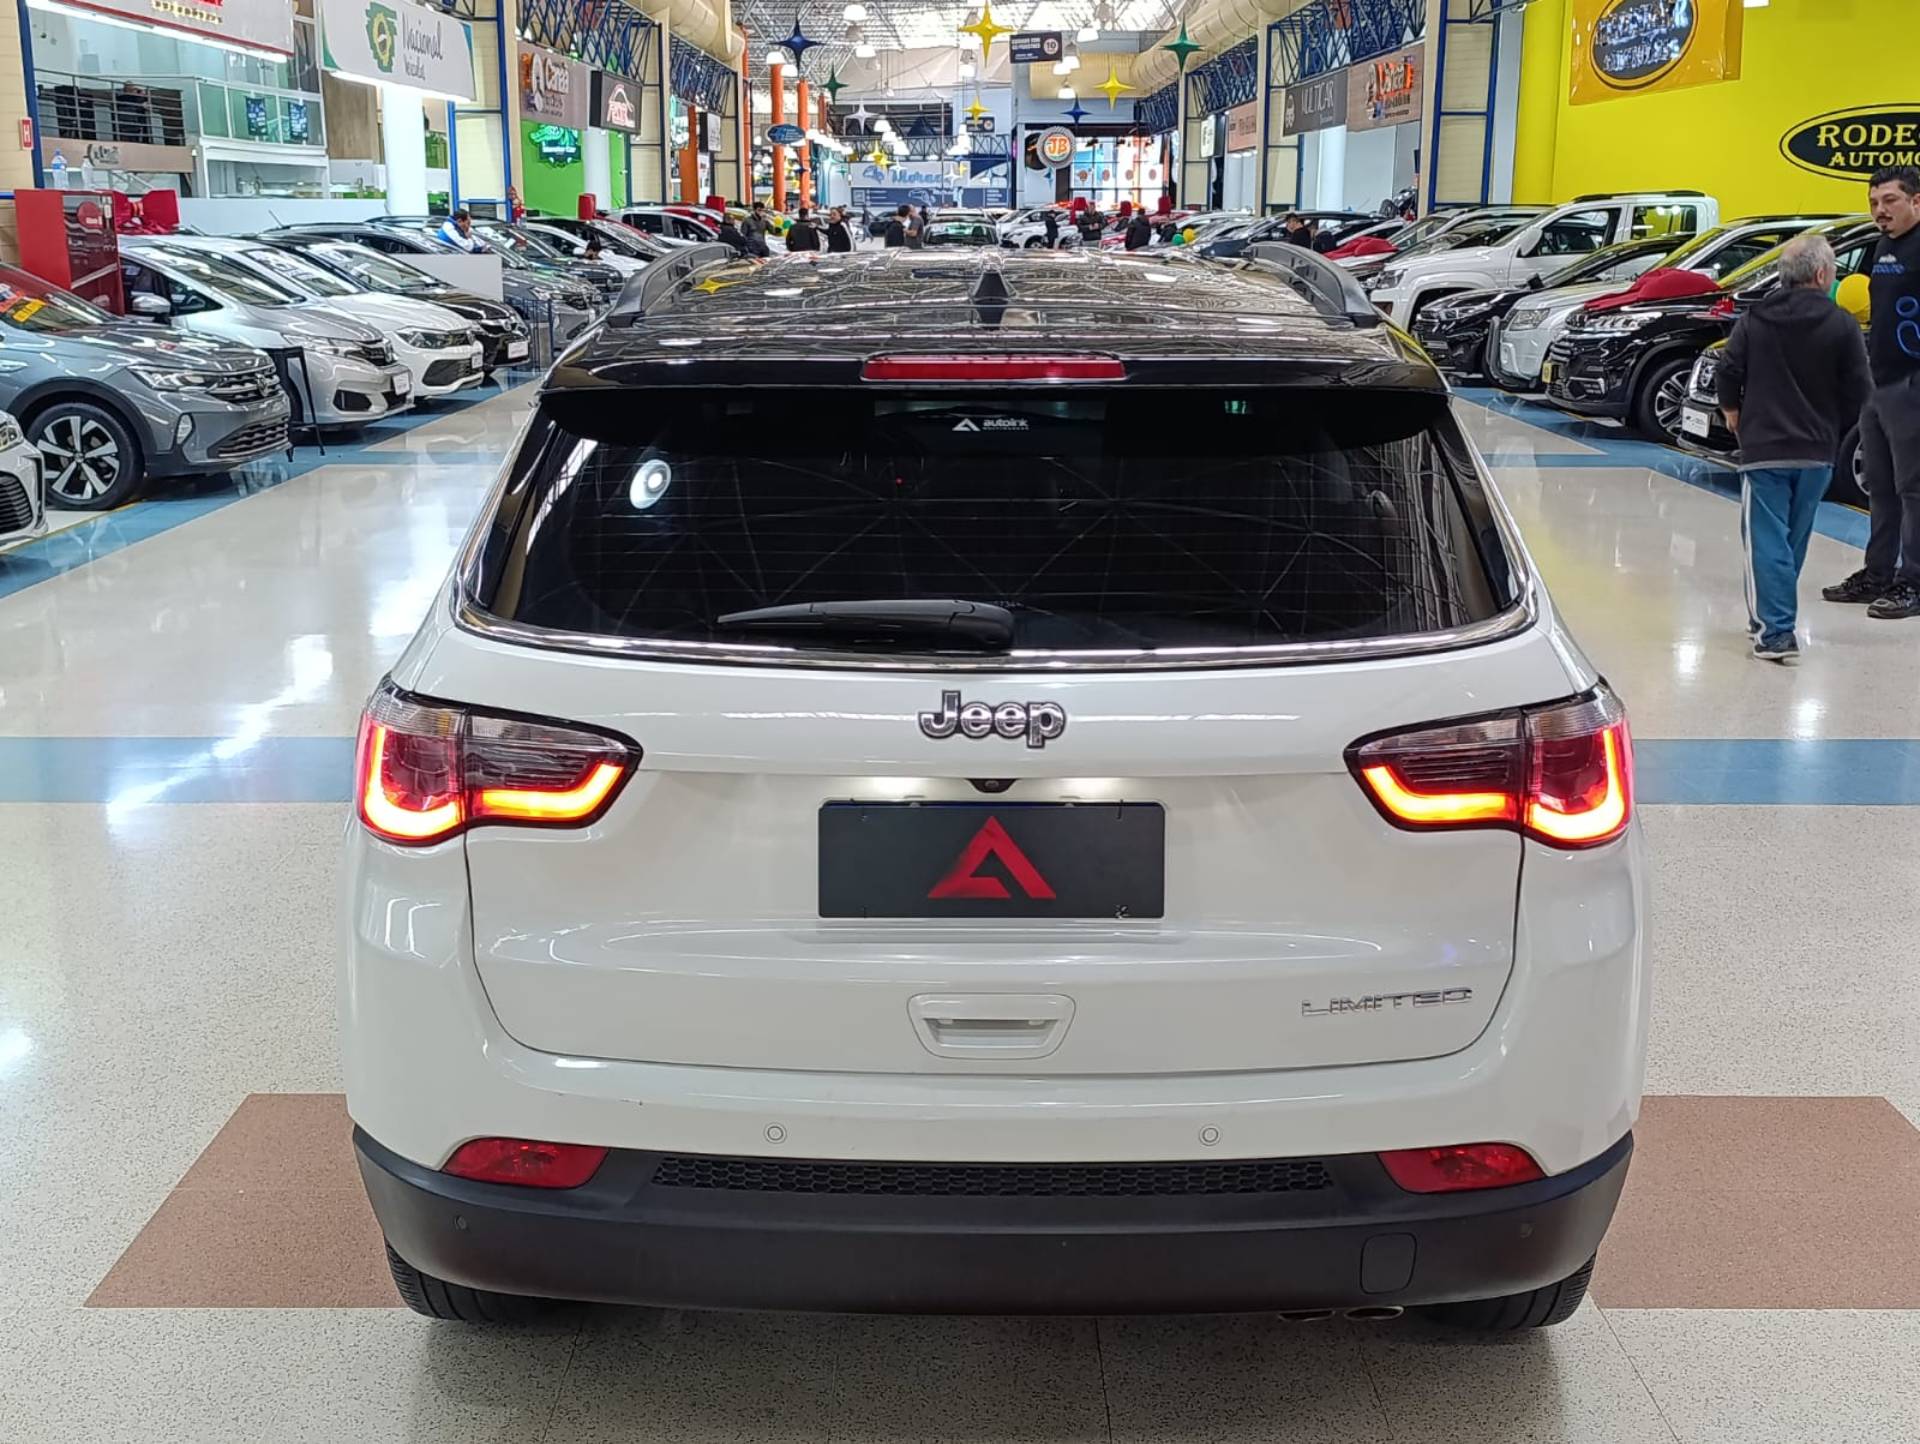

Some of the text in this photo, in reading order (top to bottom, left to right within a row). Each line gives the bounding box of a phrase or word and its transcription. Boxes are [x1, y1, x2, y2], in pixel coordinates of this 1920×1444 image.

[401, 11, 443, 60] Nacional
[1048, 137, 1067, 154] JB
[918, 690, 1066, 748] Jeep
[1302, 987, 1472, 1016] LIMITED
